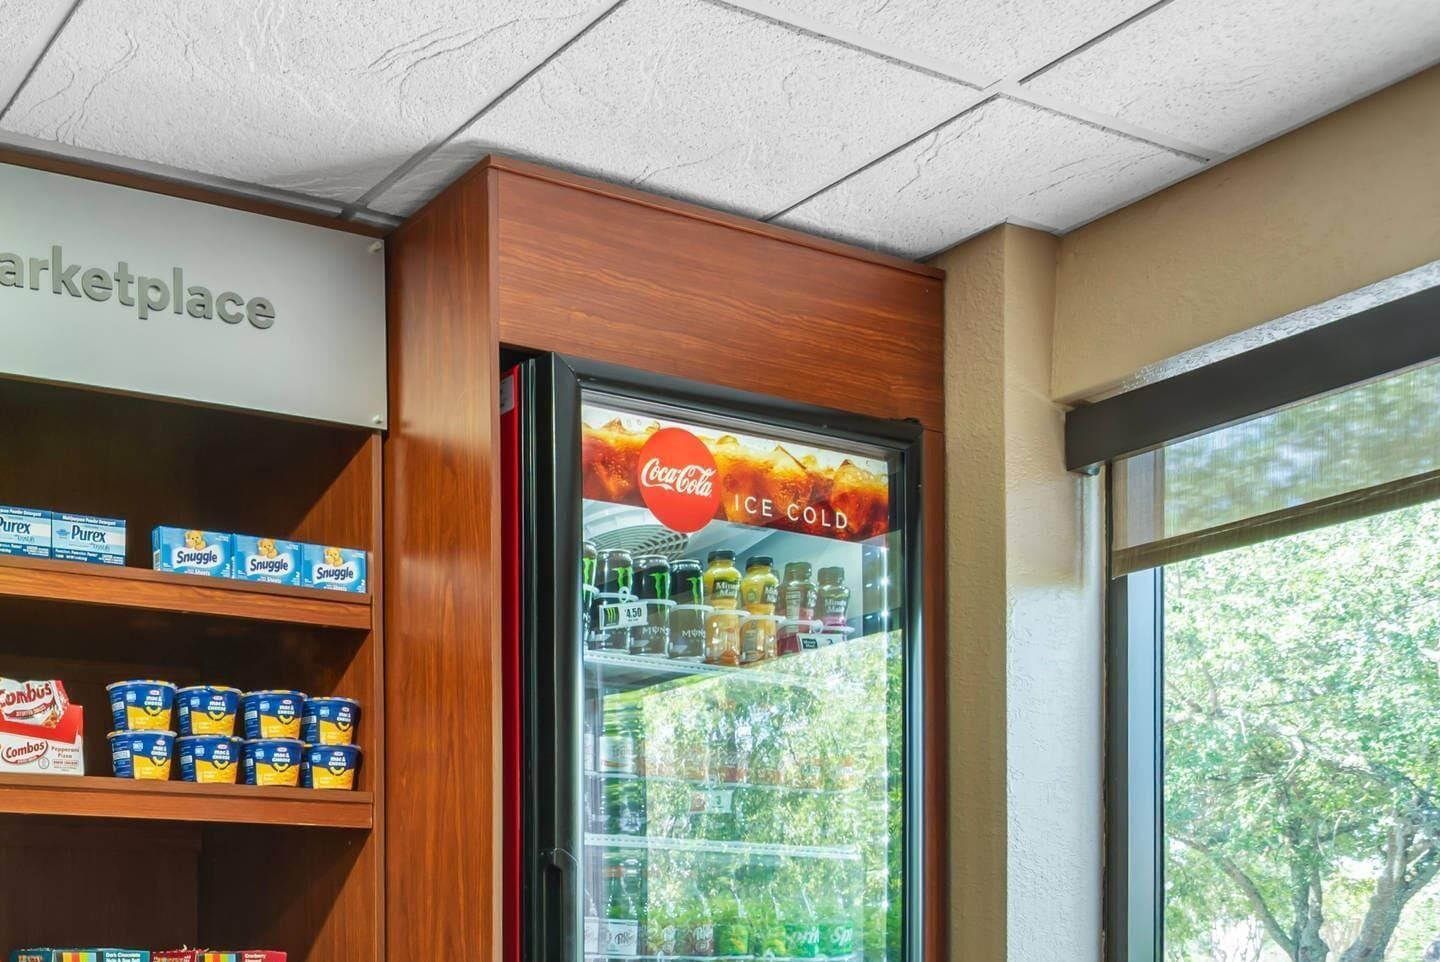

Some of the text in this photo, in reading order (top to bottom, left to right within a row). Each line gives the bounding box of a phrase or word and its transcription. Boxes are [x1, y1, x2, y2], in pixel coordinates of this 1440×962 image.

[640, 457, 717, 498] Coca-Cola
[734, 494, 849, 530] ICE COLD
[71, 525, 107, 543] Purex
[176, 550, 218, 565] Snuggle
[249, 558, 289, 573] Snuggle
[316, 567, 354, 580] Snuggle
[6, 741, 45, 759] Combos
[51, 745, 80, 753] Pepperoni
